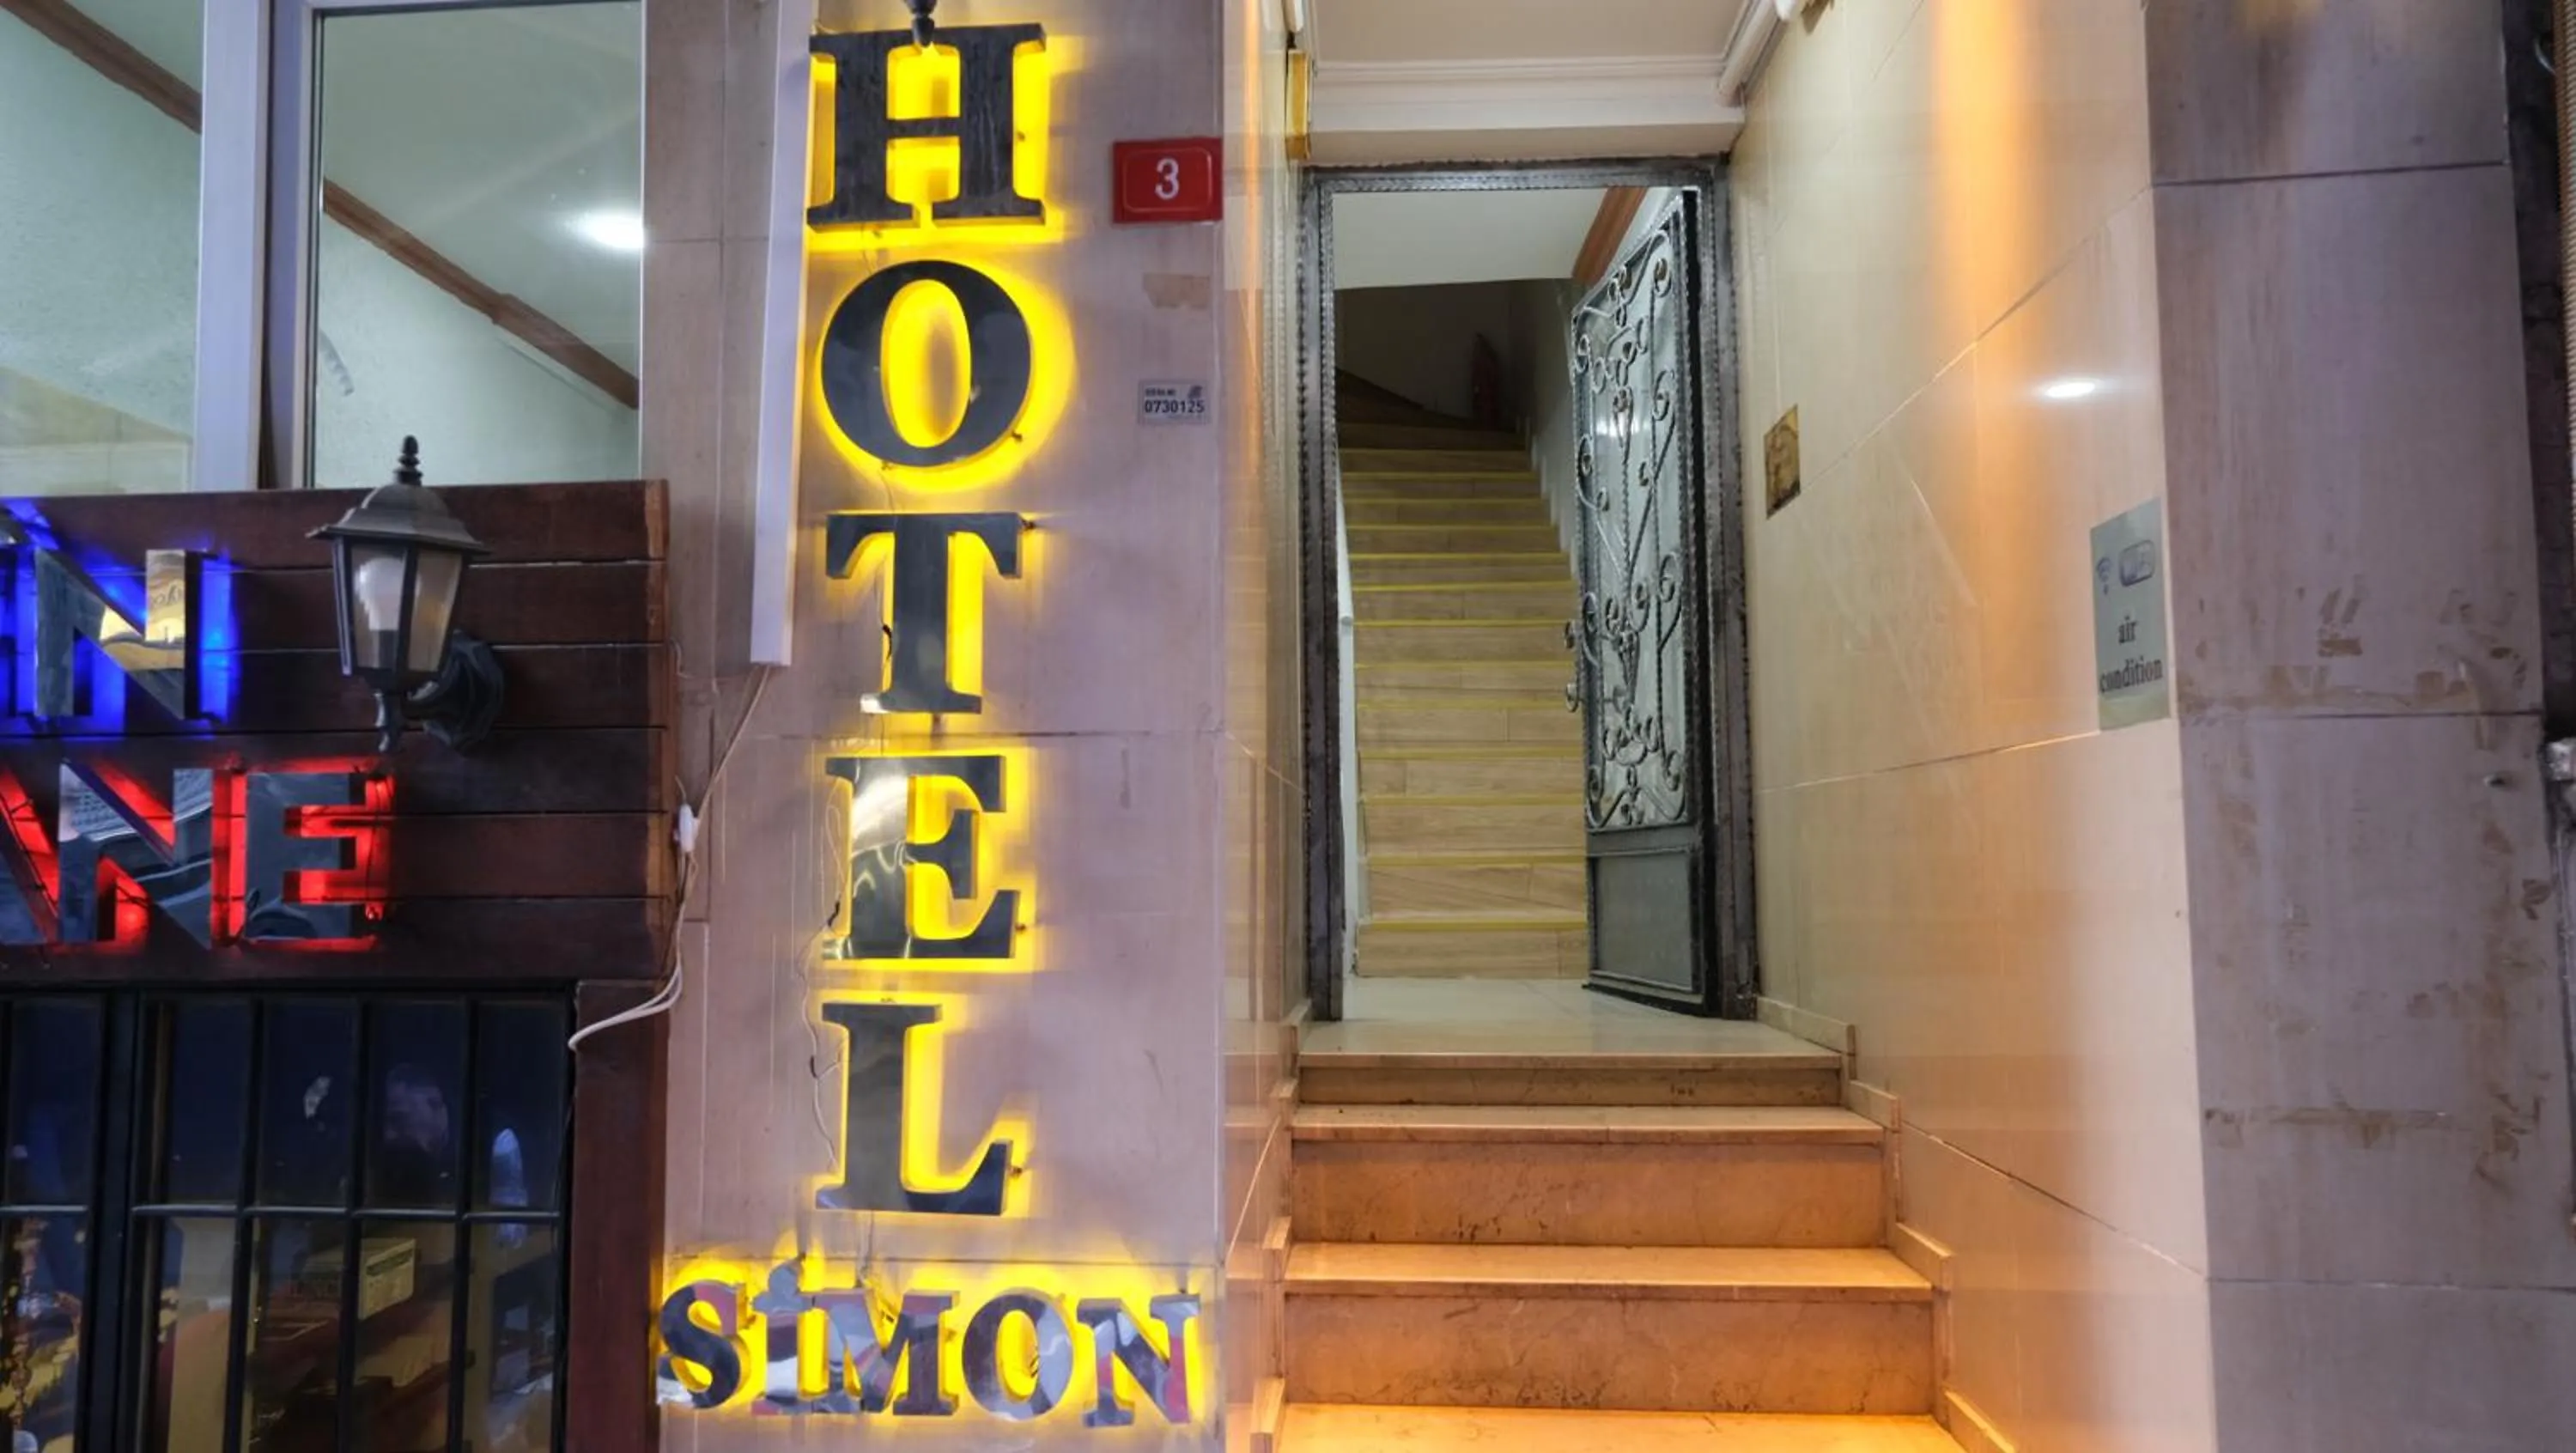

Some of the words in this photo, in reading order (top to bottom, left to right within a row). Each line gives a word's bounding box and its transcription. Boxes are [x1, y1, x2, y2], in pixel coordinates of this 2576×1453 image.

[1155, 158, 1179, 200] 3
[1145, 399, 1205, 414] 0730125
[807, 23, 1046, 1216] HOTEL
[2118, 616, 2138, 645] air
[2099, 655, 2164, 693] condition
